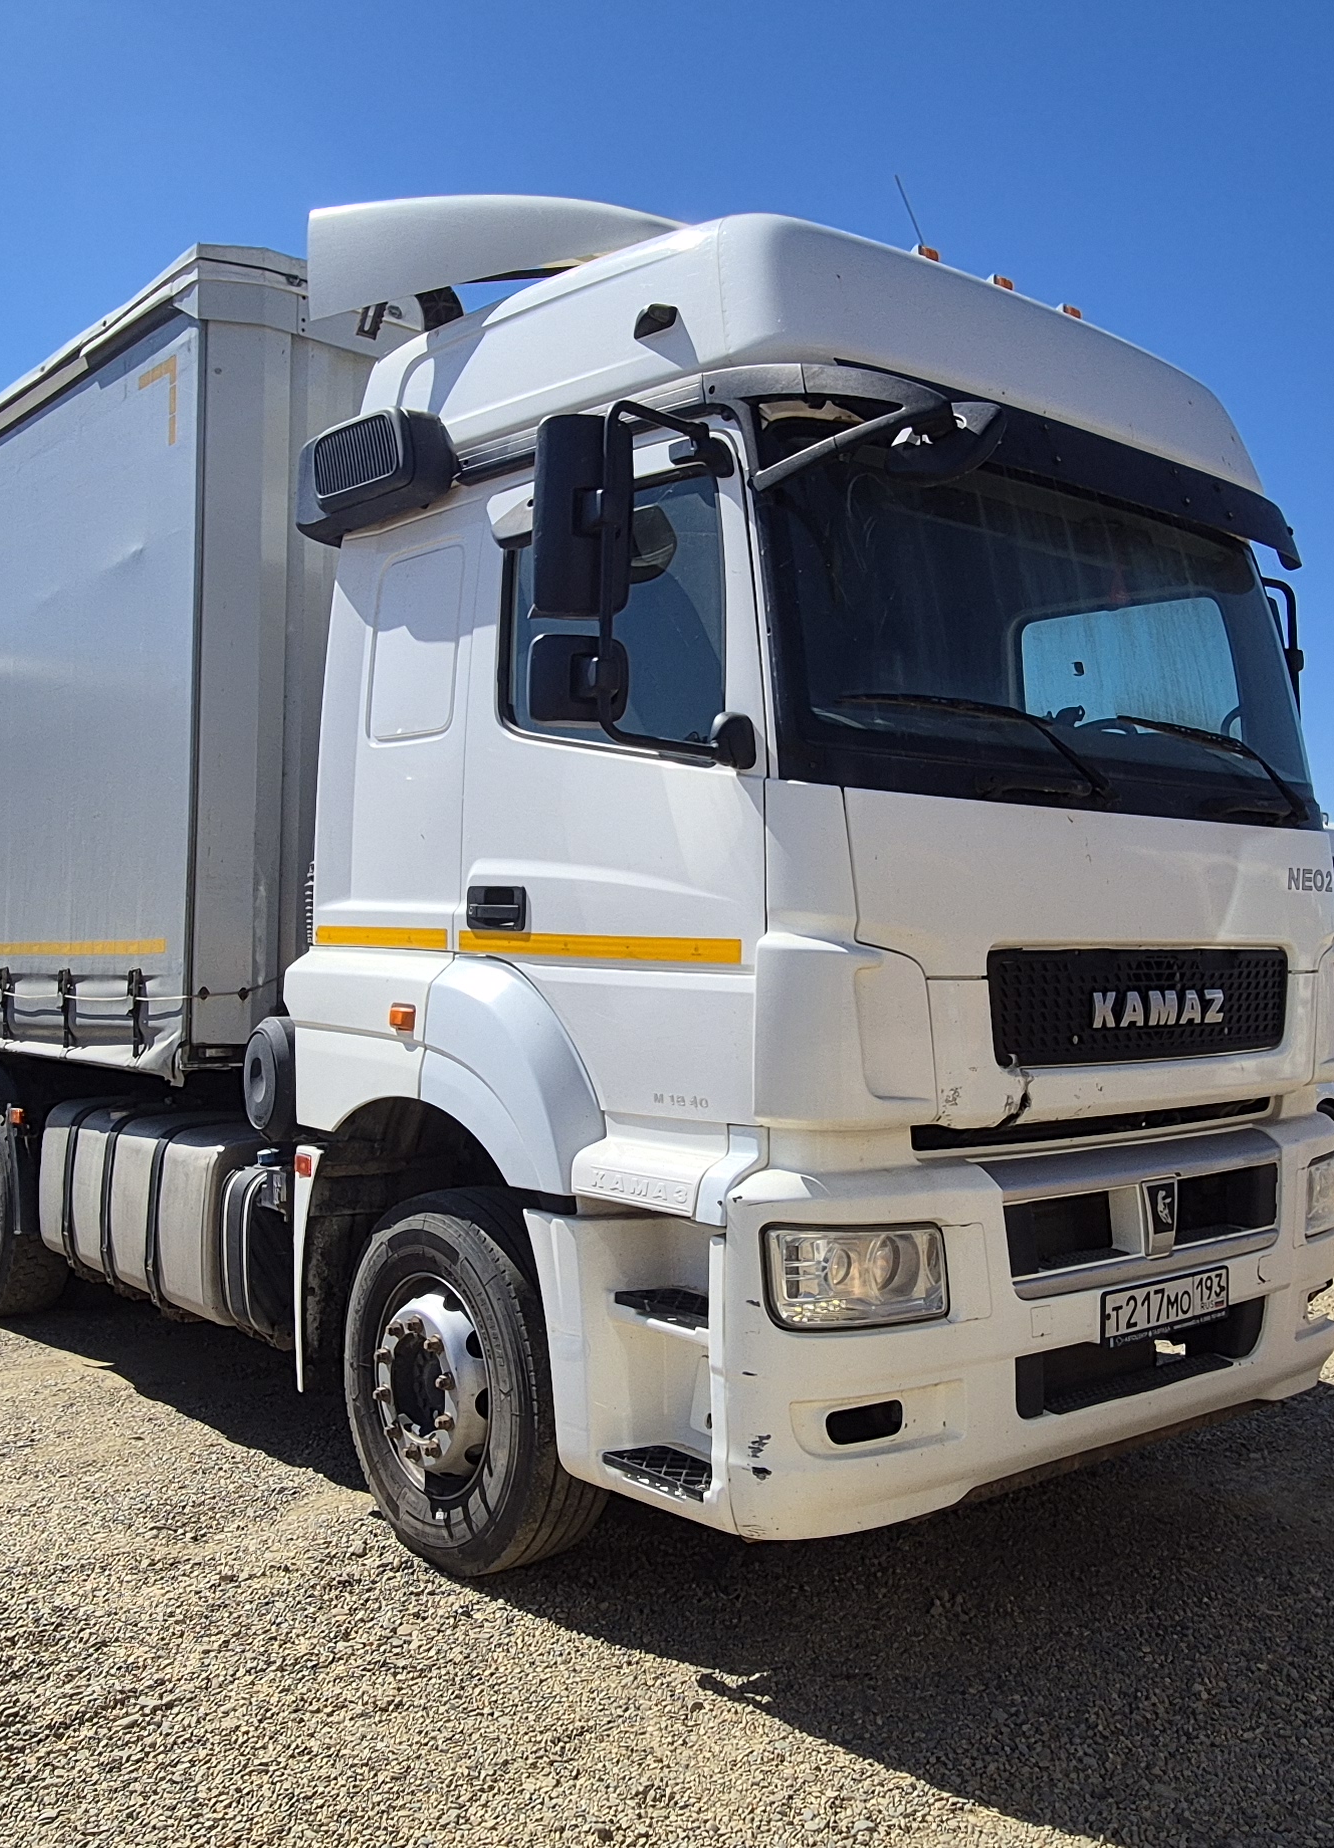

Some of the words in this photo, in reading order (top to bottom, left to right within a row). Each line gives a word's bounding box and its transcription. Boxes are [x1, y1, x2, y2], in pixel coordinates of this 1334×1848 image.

[1287, 867, 1333, 892] NEO2
[1092, 989, 1224, 1028] KAMAZ
[1196, 1273, 1225, 1302] 193
[1201, 1301, 1214, 1310] RUS
